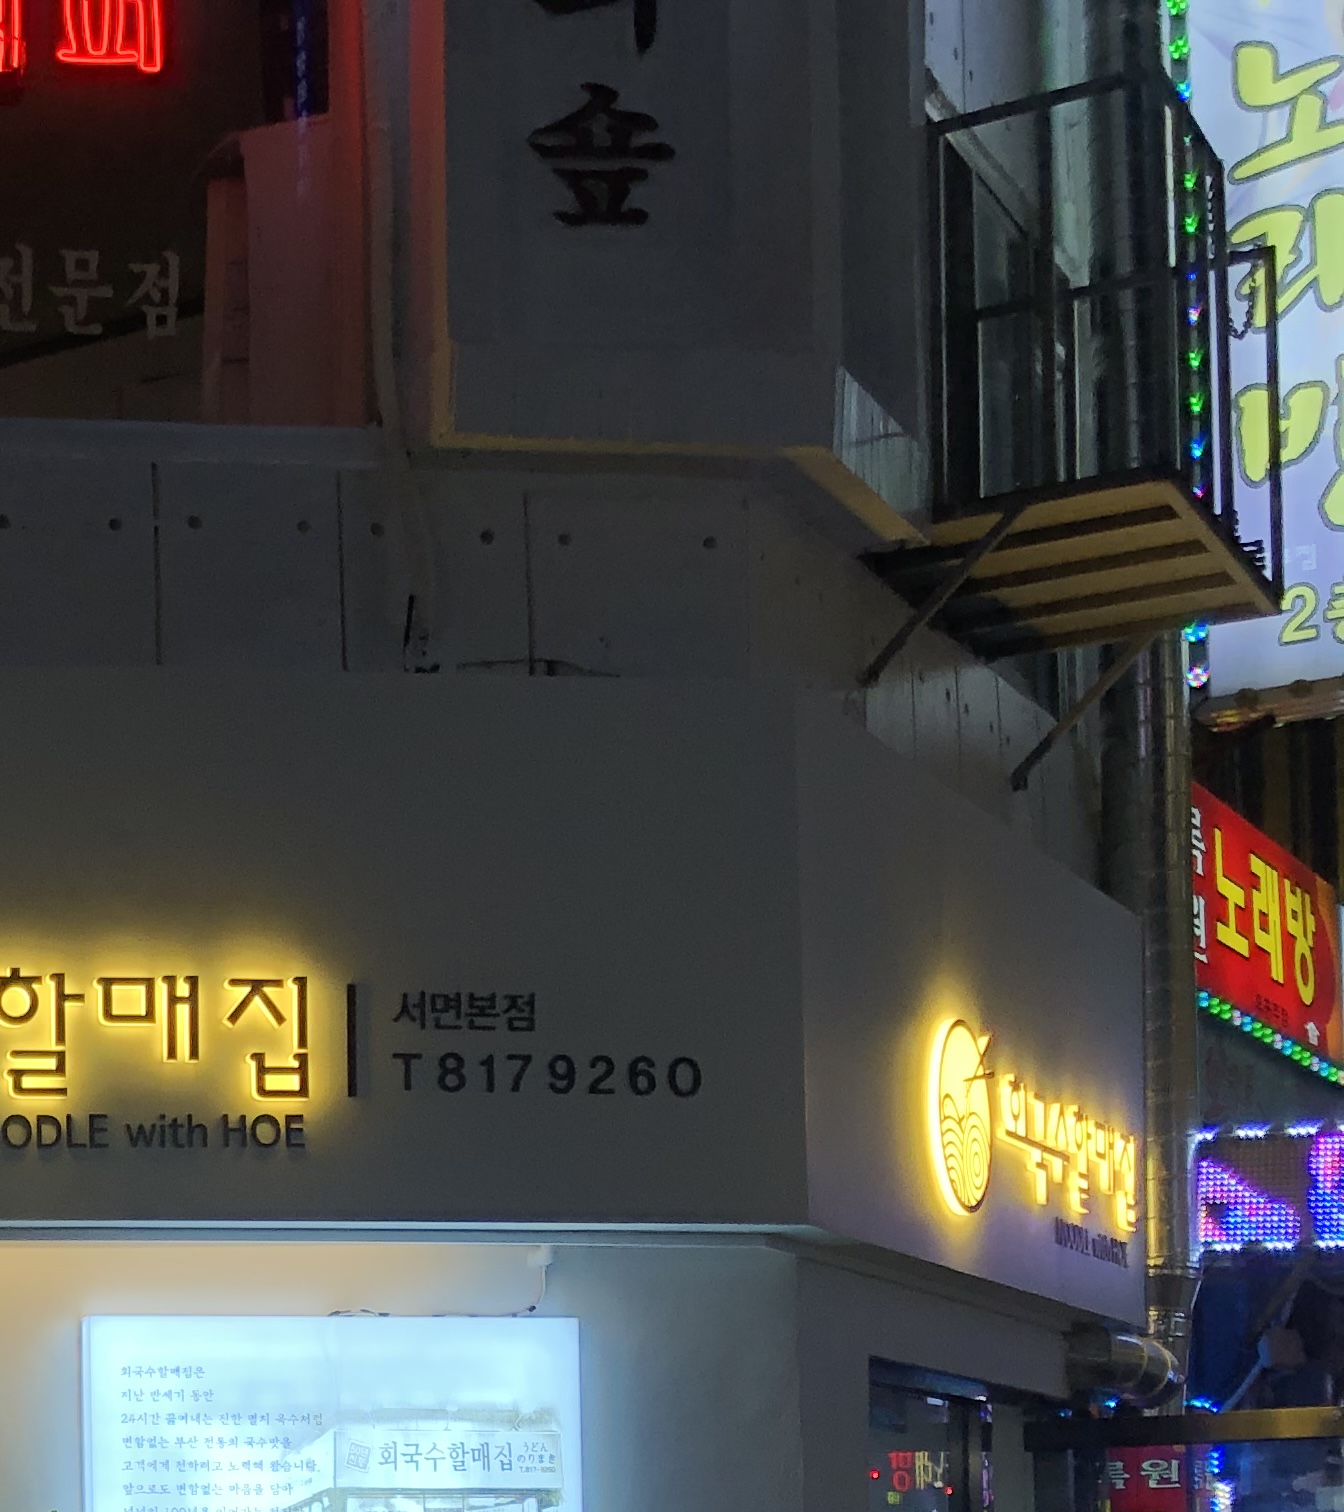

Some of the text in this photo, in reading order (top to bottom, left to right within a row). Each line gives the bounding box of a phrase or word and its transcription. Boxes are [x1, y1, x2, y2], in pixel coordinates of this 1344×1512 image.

[1213, 827, 1316, 1006] 노래방
[391, 990, 537, 1032] 서면본점
[436, 1053, 703, 1098] 8179260
[124, 1114, 209, 1150] with
[221, 1113, 306, 1149] HOE
[121, 1365, 205, 1379] 회국수할매집은
[121, 1388, 215, 1403] 지난 반세기 동안
[121, 1412, 161, 1426] 24시간
[218, 1411, 242, 1426] 진한
[248, 1412, 270, 1426] 멸치
[275, 1412, 323, 1426] 육수처럼
[122, 1435, 292, 1450] 변함없는 부산 전통의 국수맛을
[523, 1441, 548, 1453] うどん
[378, 1440, 513, 1472] 회국수할매집
[517, 1453, 556, 1465] のりまき
[122, 1459, 170, 1473] 고객에게
[228, 1459, 264, 1472] 노력해
[269, 1459, 321, 1473] 왔습니다.
[122, 1482, 293, 1496] 앞으로도 변함없는 마음을 담아
